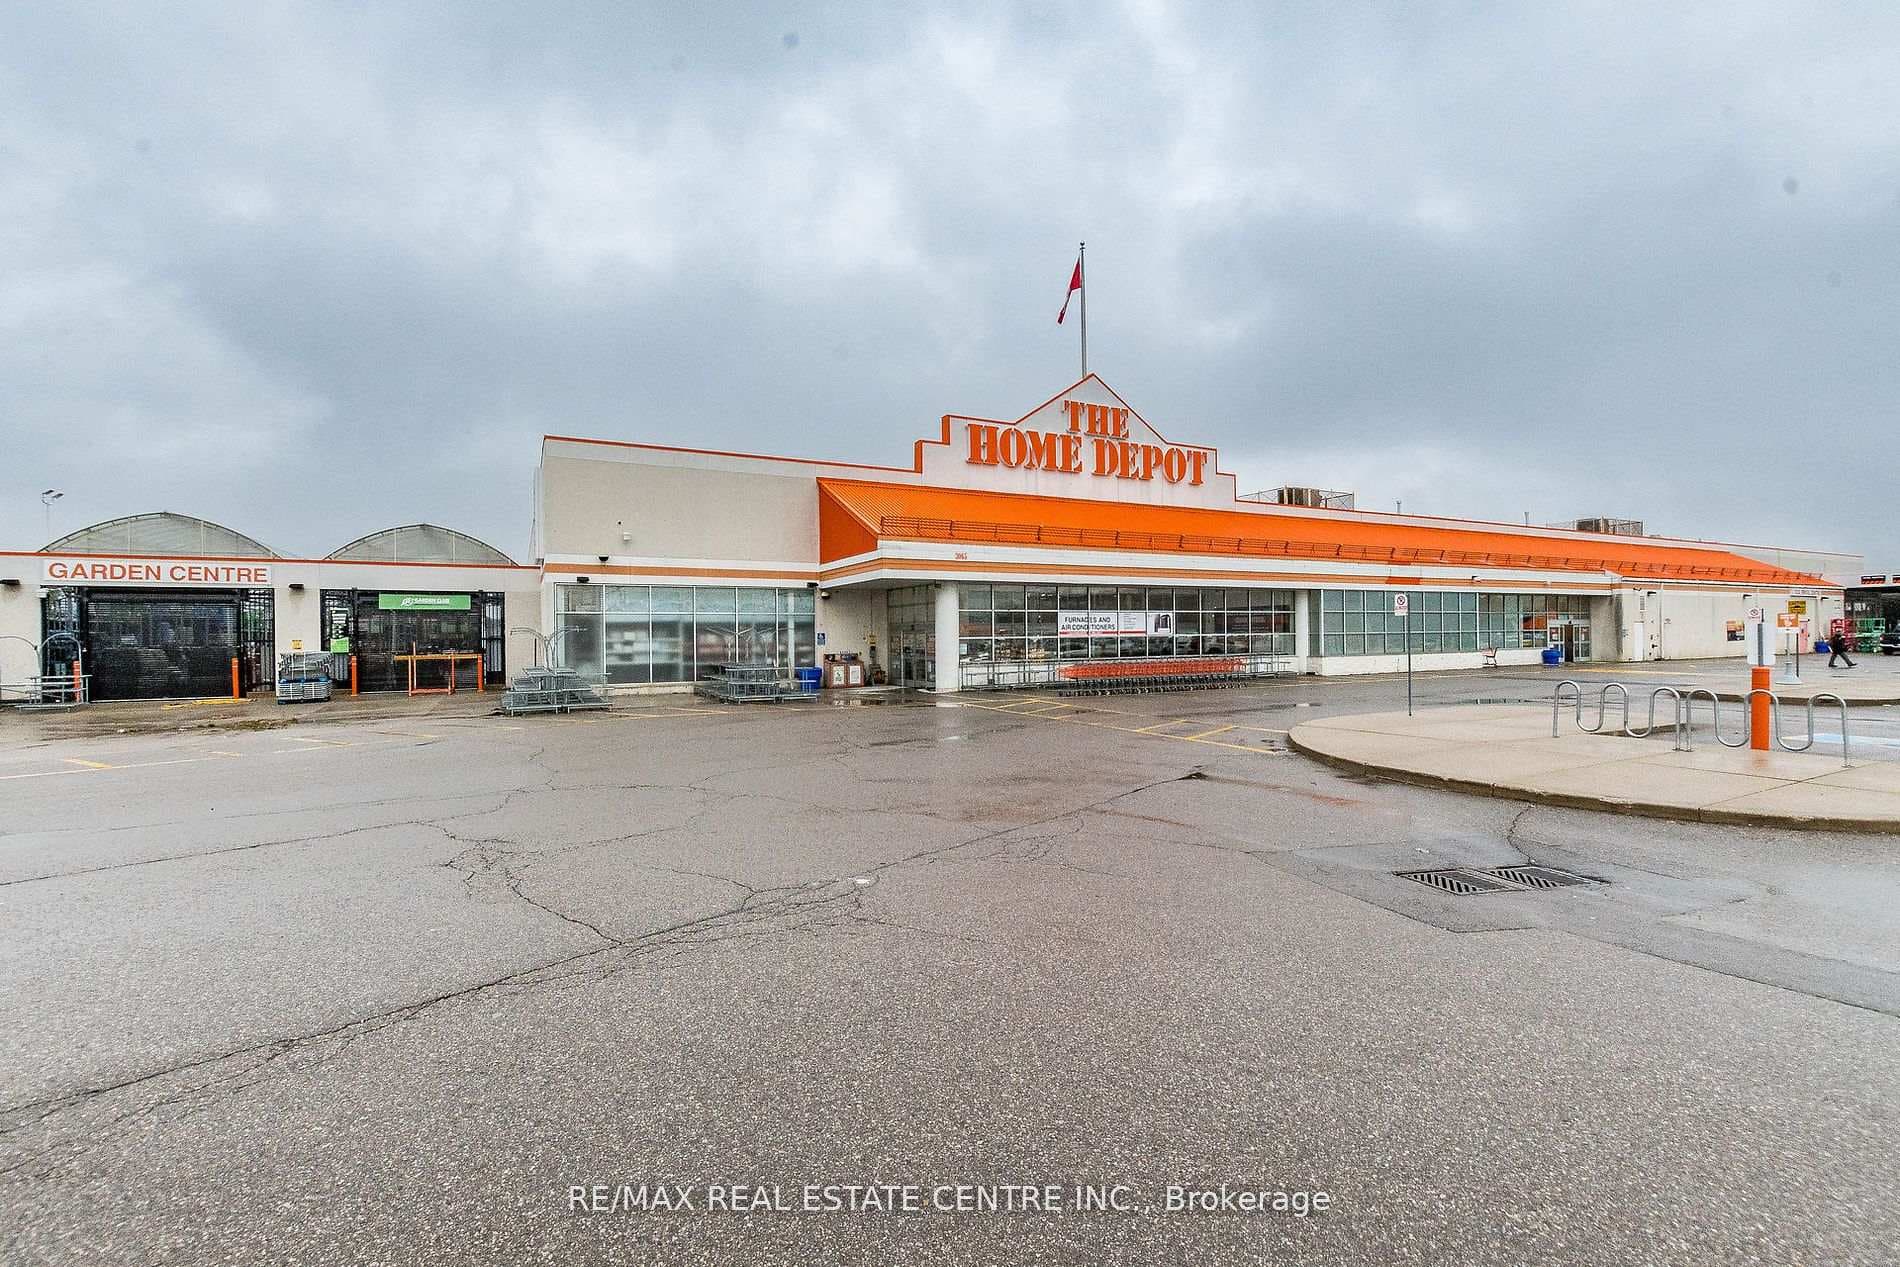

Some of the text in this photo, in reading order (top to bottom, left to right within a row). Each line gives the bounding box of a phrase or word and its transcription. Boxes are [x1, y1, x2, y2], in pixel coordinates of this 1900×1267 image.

[1062, 399, 1130, 439] THE
[966, 423, 1208, 486] HOME DEPOT
[48, 562, 269, 583] GARDEN CENTRE
